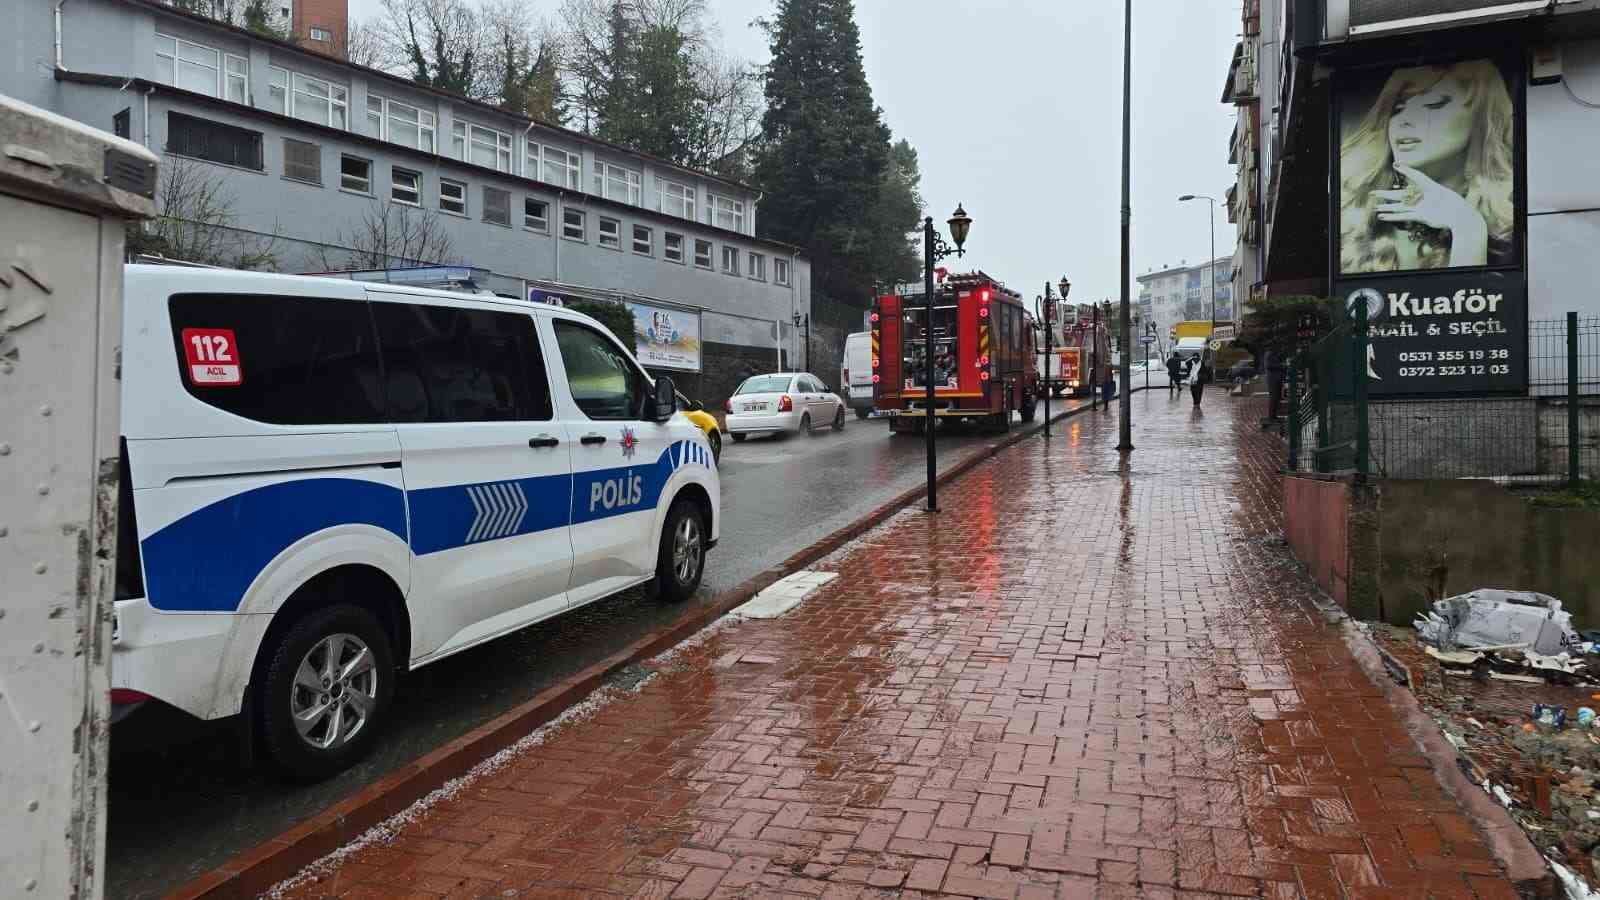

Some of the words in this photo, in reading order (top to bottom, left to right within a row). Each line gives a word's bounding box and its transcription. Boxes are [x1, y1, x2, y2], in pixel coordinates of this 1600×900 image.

[1387, 288, 1503, 317] Kuaför
[1426, 323, 1441, 336] &
[1448, 317, 1507, 337] SEÇİL
[191, 335, 232, 361] 112
[1399, 352, 1433, 361] 0531
[1437, 350, 1464, 360] 355
[1467, 350, 1484, 360] 19
[1489, 349, 1509, 359] 38
[1399, 366, 1435, 376] 0372
[1439, 365, 1466, 376] 323
[1470, 365, 1486, 375] 12
[1490, 364, 1509, 374] 03
[590, 469, 642, 512] POLİS
